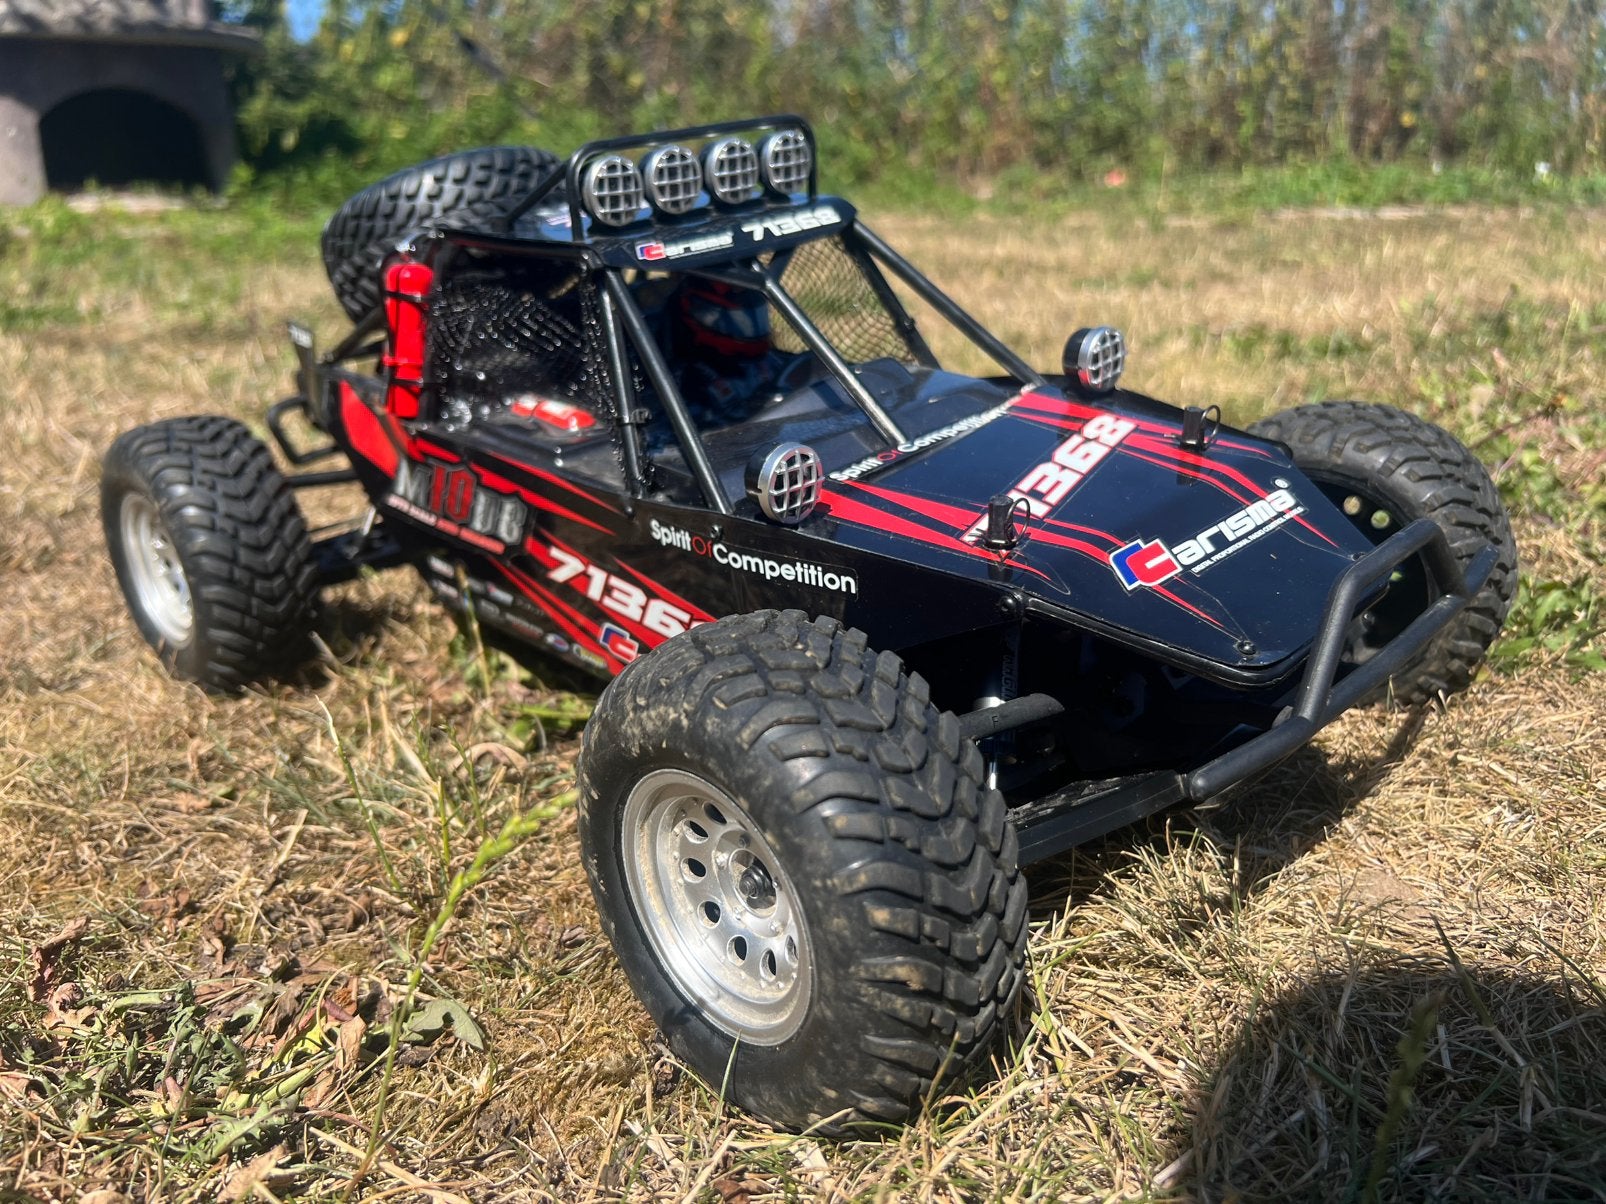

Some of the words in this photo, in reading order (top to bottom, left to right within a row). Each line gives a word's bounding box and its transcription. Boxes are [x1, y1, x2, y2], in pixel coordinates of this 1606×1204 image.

[741, 205, 842, 242] 71368
[1109, 489, 1297, 590] Carisma
[546, 545, 709, 635] 7136
